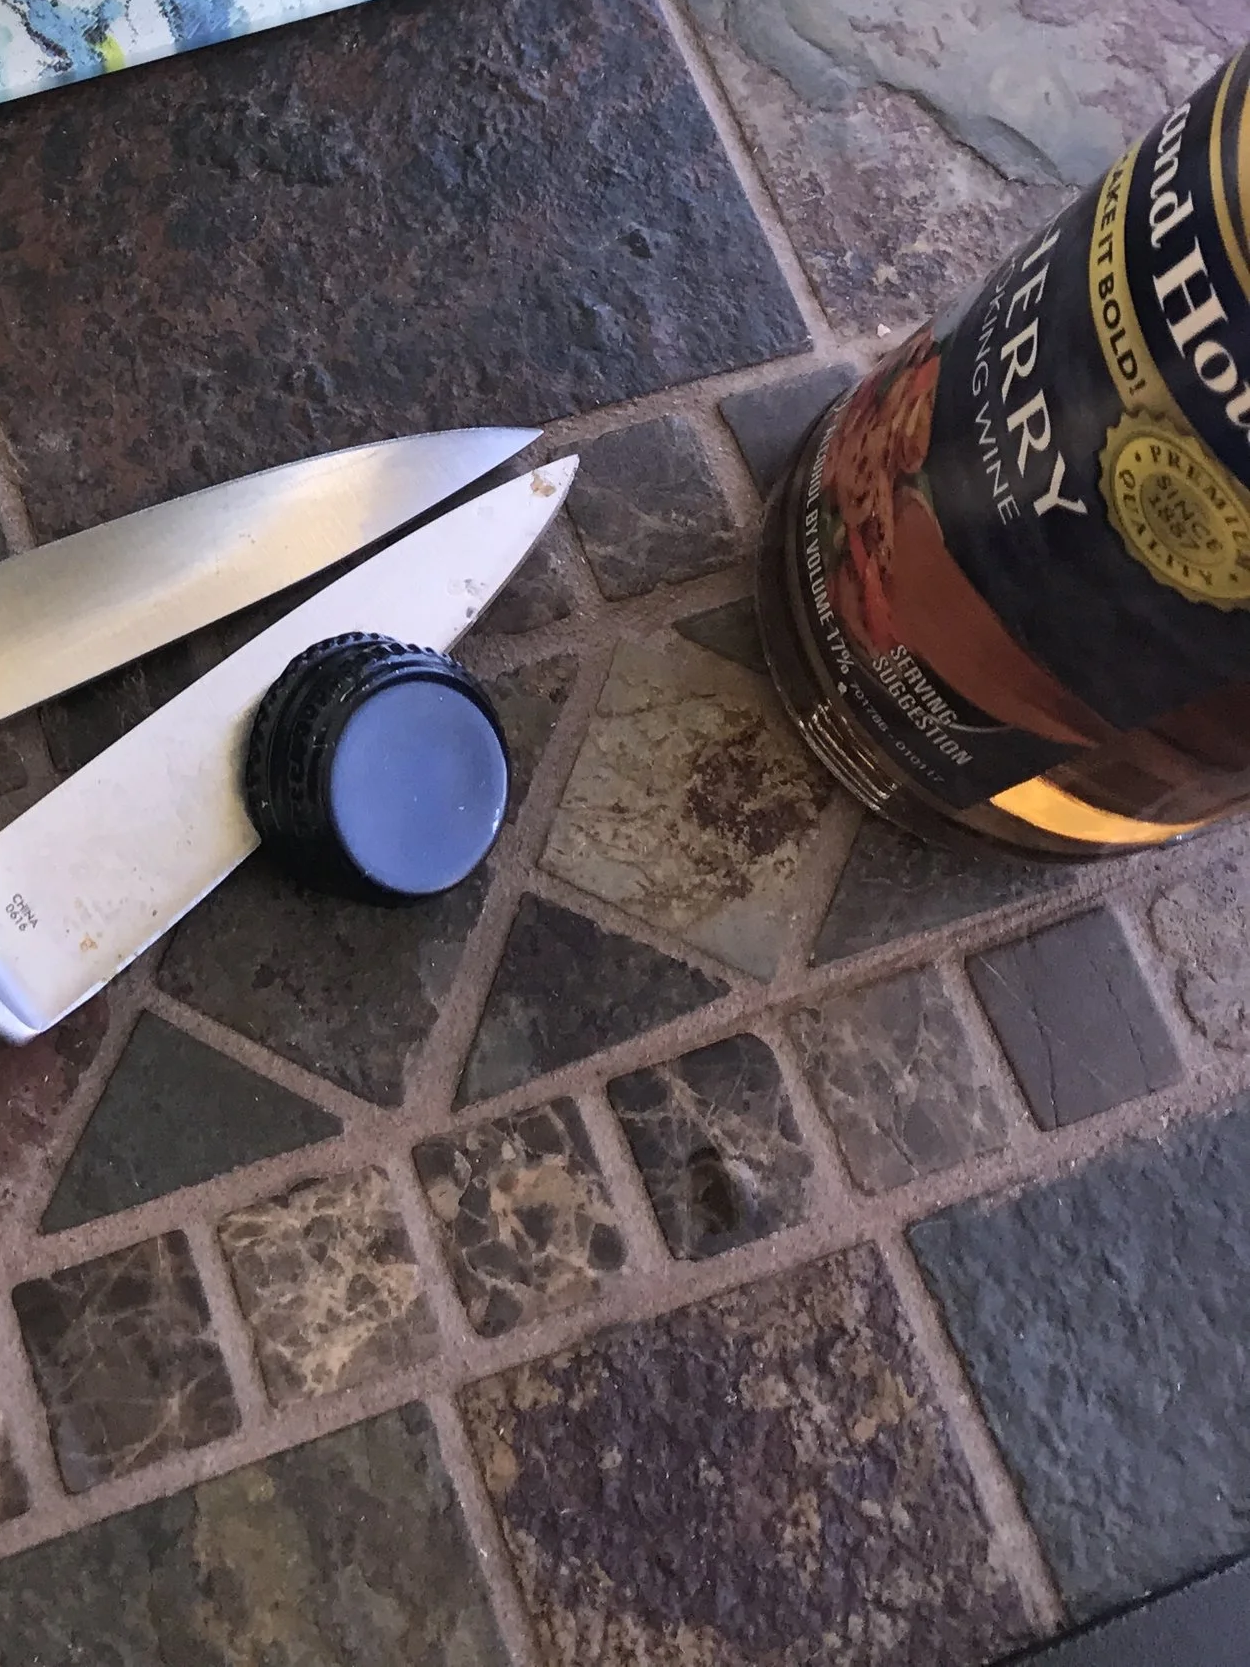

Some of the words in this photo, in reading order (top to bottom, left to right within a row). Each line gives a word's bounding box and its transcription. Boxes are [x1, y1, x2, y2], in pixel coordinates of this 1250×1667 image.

[1097, 233, 1113, 267] IT
[1097, 271, 1147, 396] BOLD!
[975, 401, 1021, 525] WINE
[805, 508, 819, 537] BY
[1150, 444, 1250, 570] PREMIU
[806, 537, 835, 626] VOLUME
[827, 626, 855, 675] 17%
[890, 644, 958, 727] SERVING
[872, 654, 974, 766] SUGGESTION
[12, 893, 38, 929] CHINA
